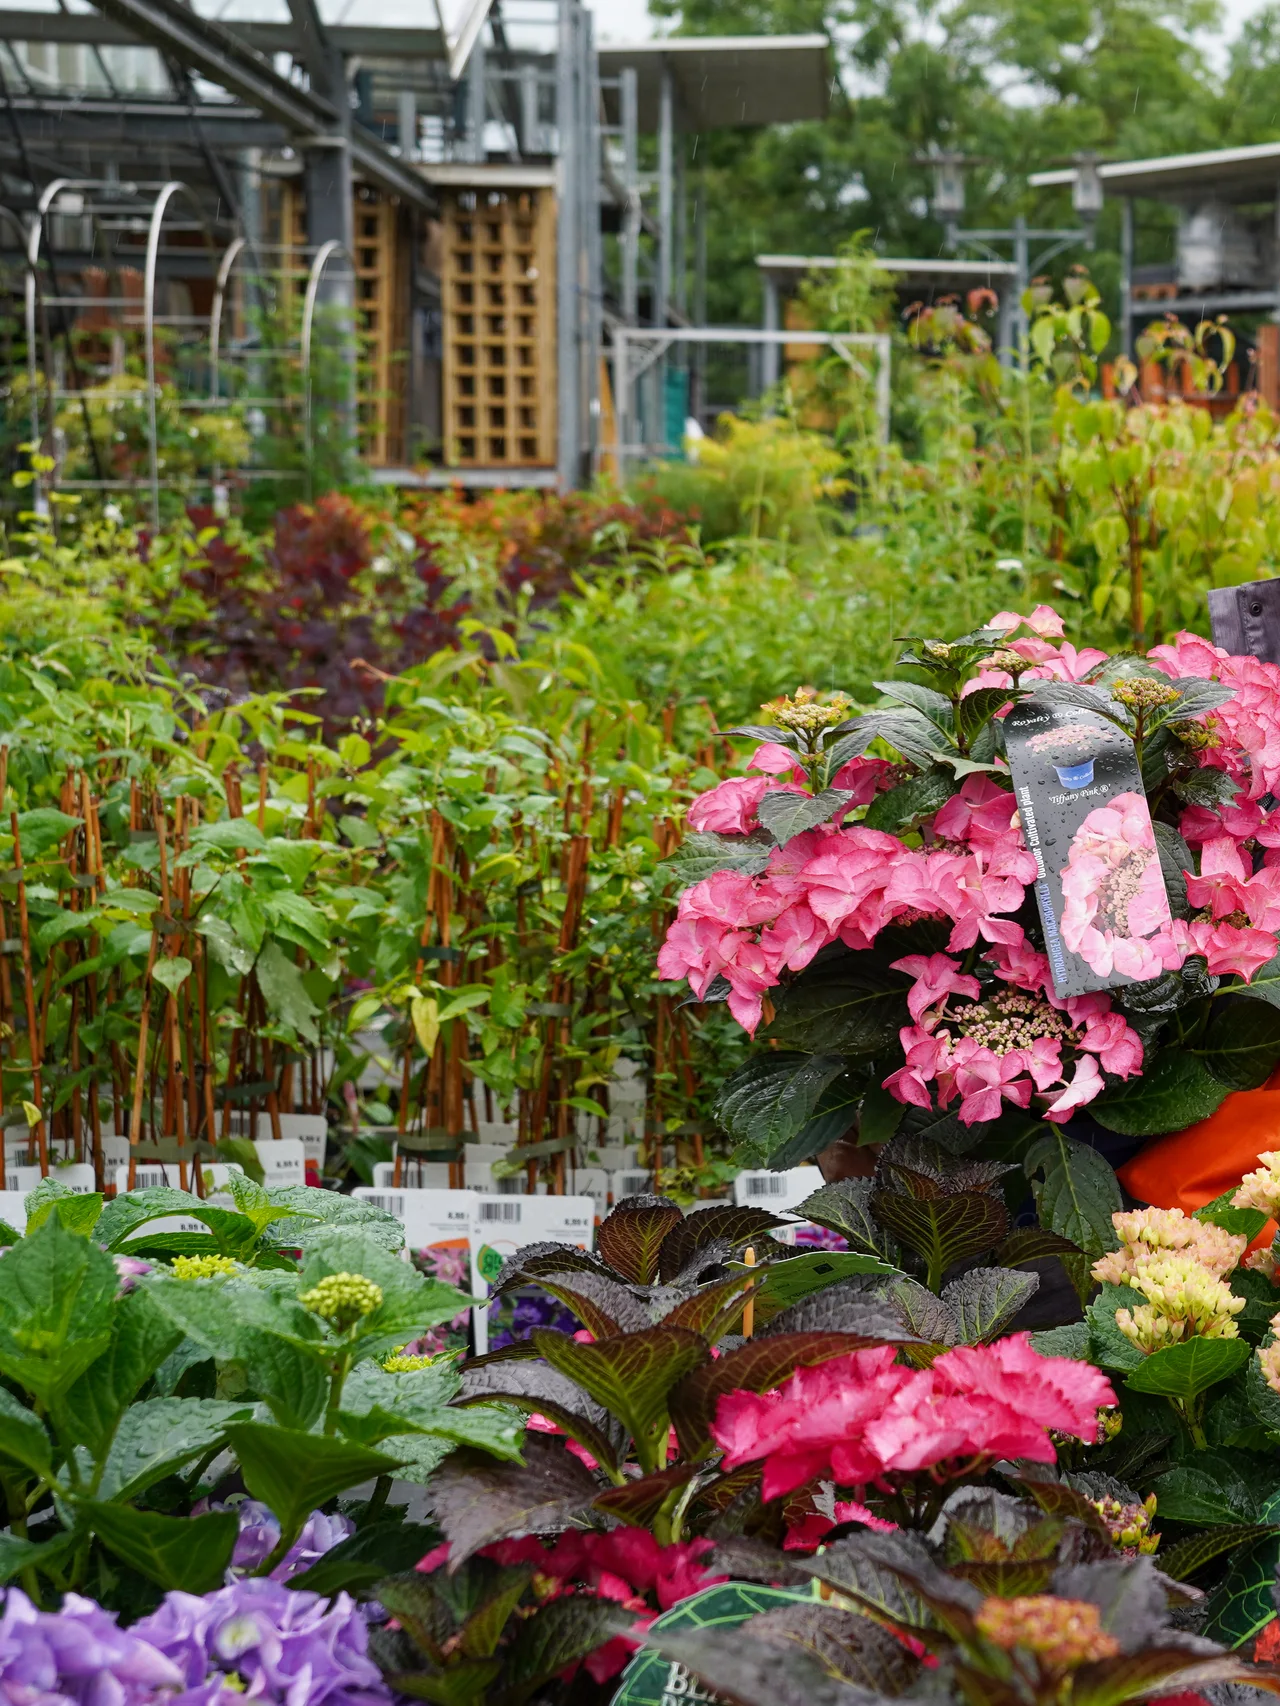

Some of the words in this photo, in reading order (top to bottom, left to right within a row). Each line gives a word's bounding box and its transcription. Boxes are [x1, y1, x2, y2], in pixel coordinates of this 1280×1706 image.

[1011, 713, 1051, 727] Royalty
[1018, 785, 1034, 806] plant
[1080, 788, 1101, 798] Pink
[1022, 806, 1040, 847] Cultivated
[1033, 847, 1047, 879] Outdoor
[1039, 883, 1059, 938] MACROPHYLLA
[1050, 938, 1068, 983] HYDRANGEA
